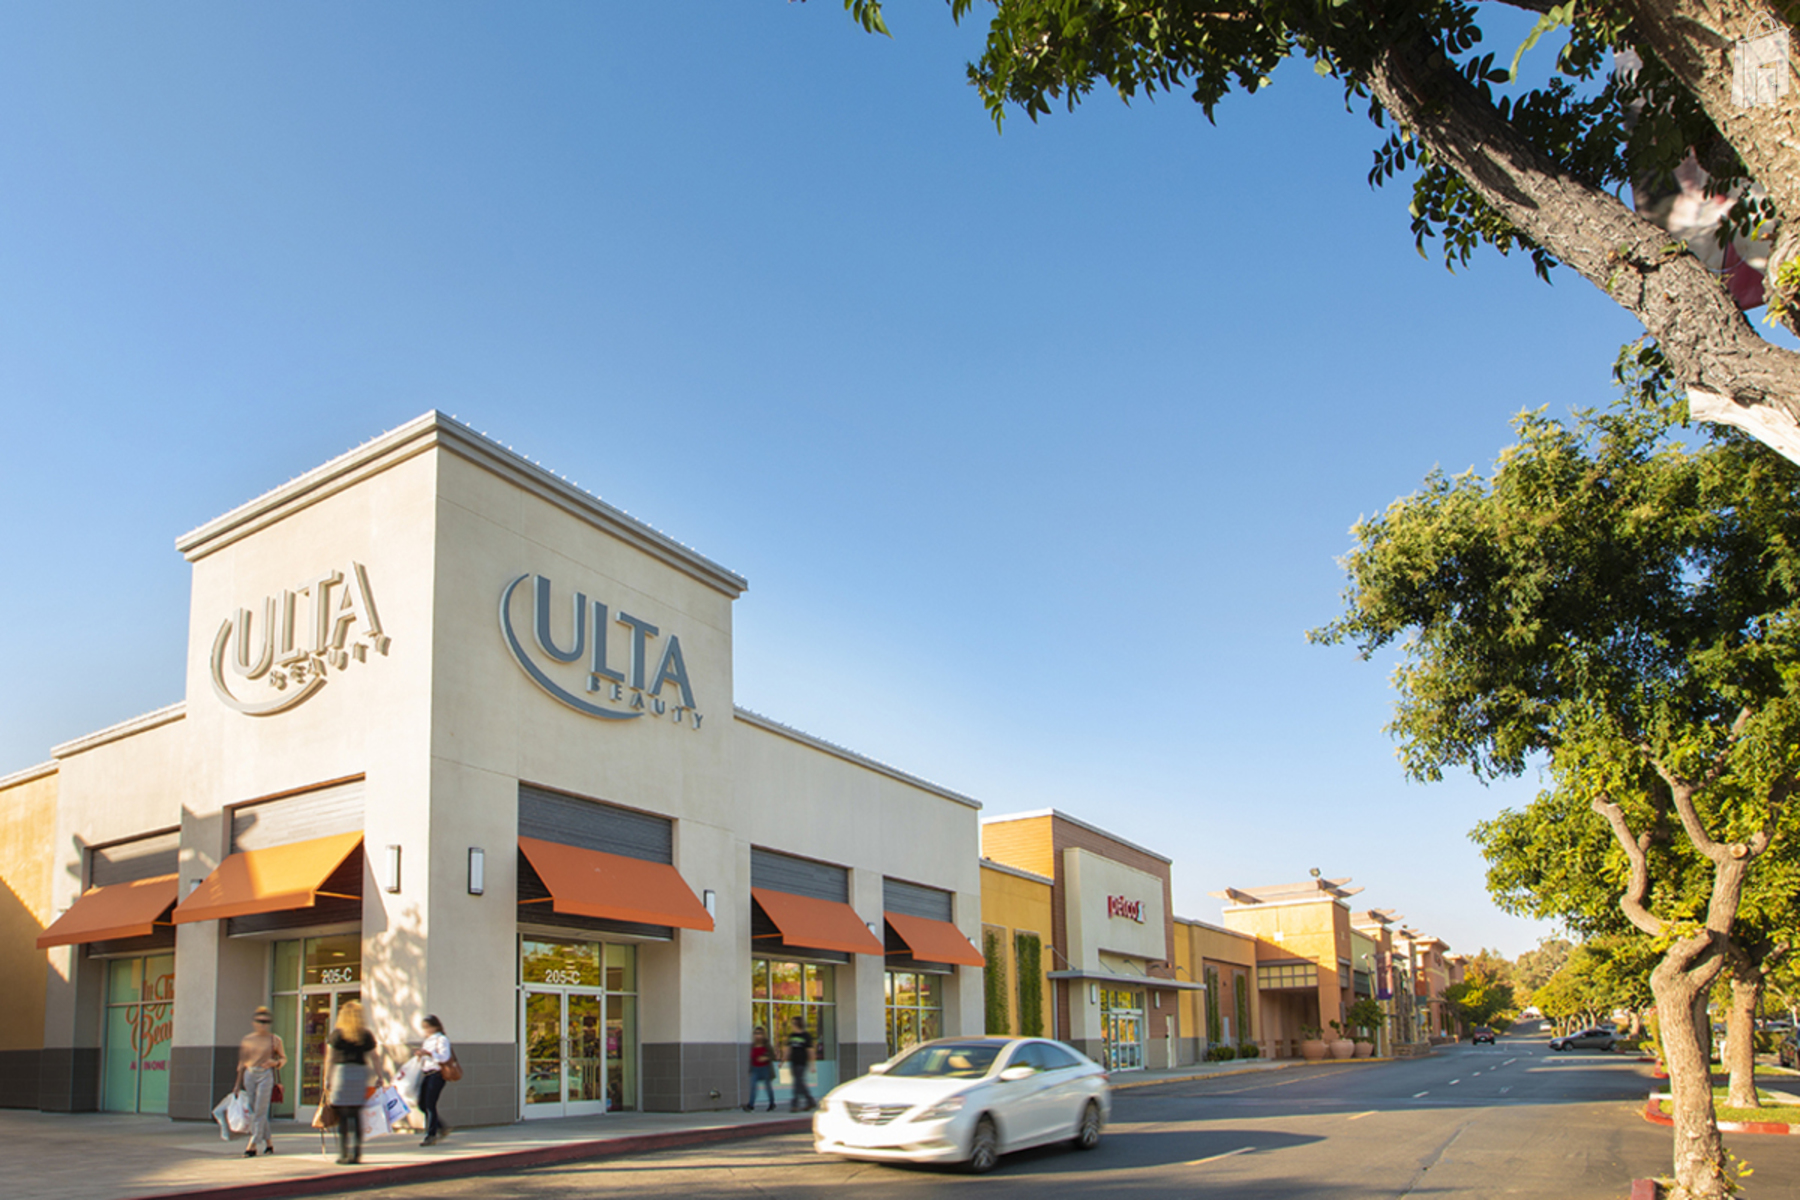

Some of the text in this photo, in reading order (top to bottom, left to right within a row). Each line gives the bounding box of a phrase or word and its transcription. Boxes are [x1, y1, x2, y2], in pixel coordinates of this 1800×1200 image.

[232, 561, 384, 680] ULTA
[533, 574, 696, 709] ULTA
[586, 676, 703, 730] BEAUTY
[1107, 895, 1140, 921] petco
[545, 969, 581, 985] 205-C
